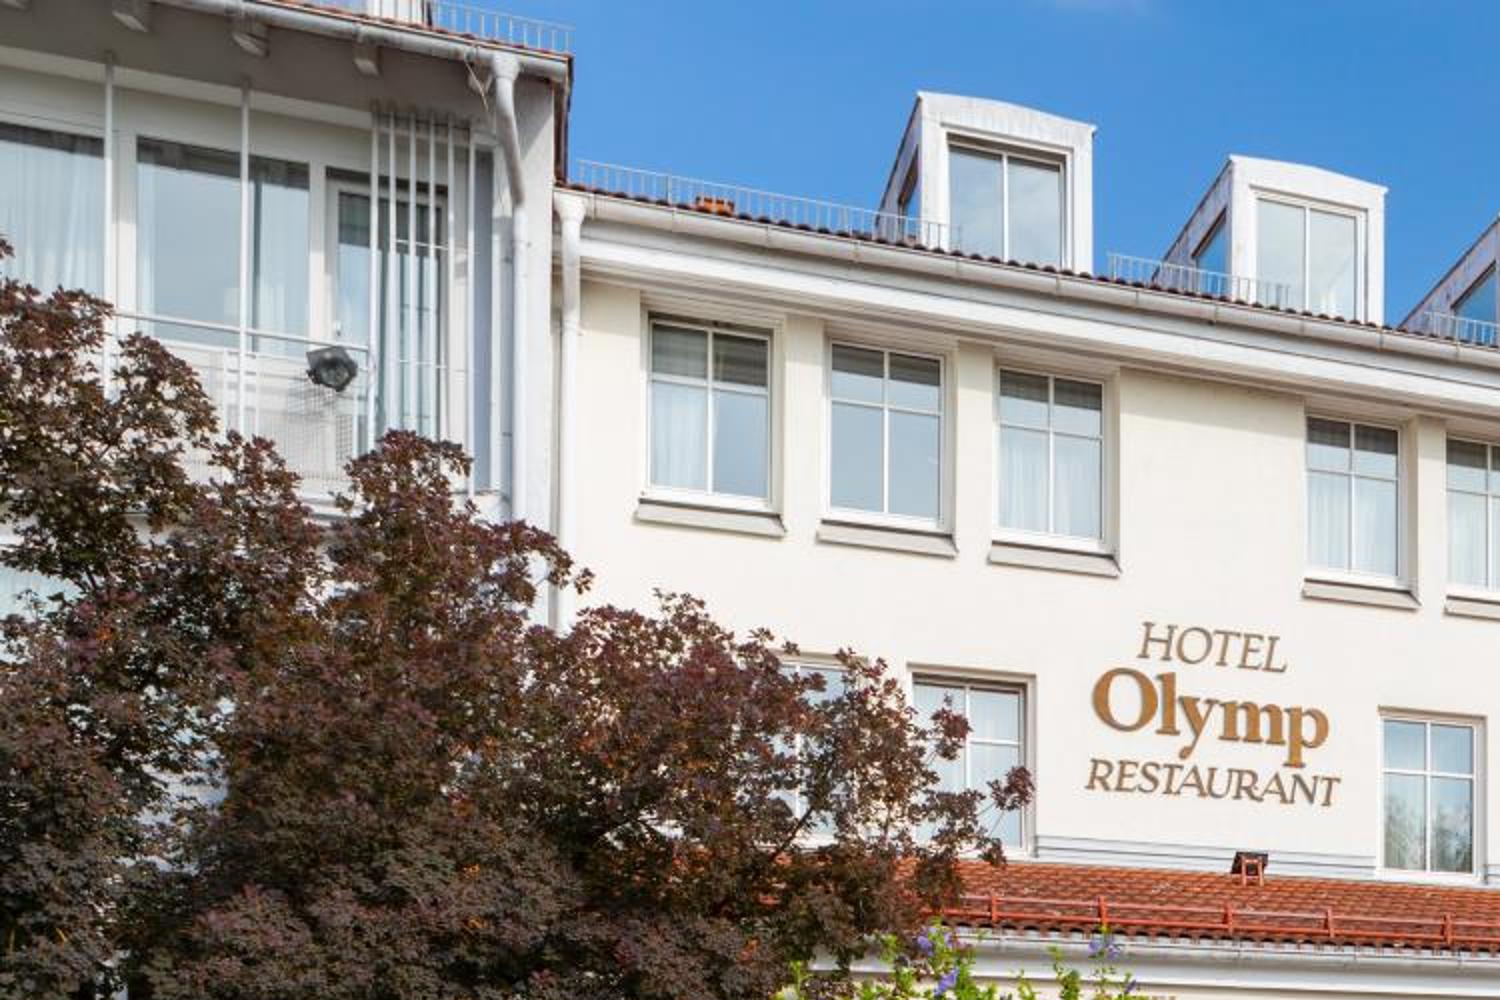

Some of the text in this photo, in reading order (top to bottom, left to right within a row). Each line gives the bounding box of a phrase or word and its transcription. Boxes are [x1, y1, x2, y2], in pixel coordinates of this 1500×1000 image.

[1136, 621, 1288, 674] HOTEL
[1091, 667, 1330, 770] Olymp
[1083, 757, 1342, 808] RESTAURANT
